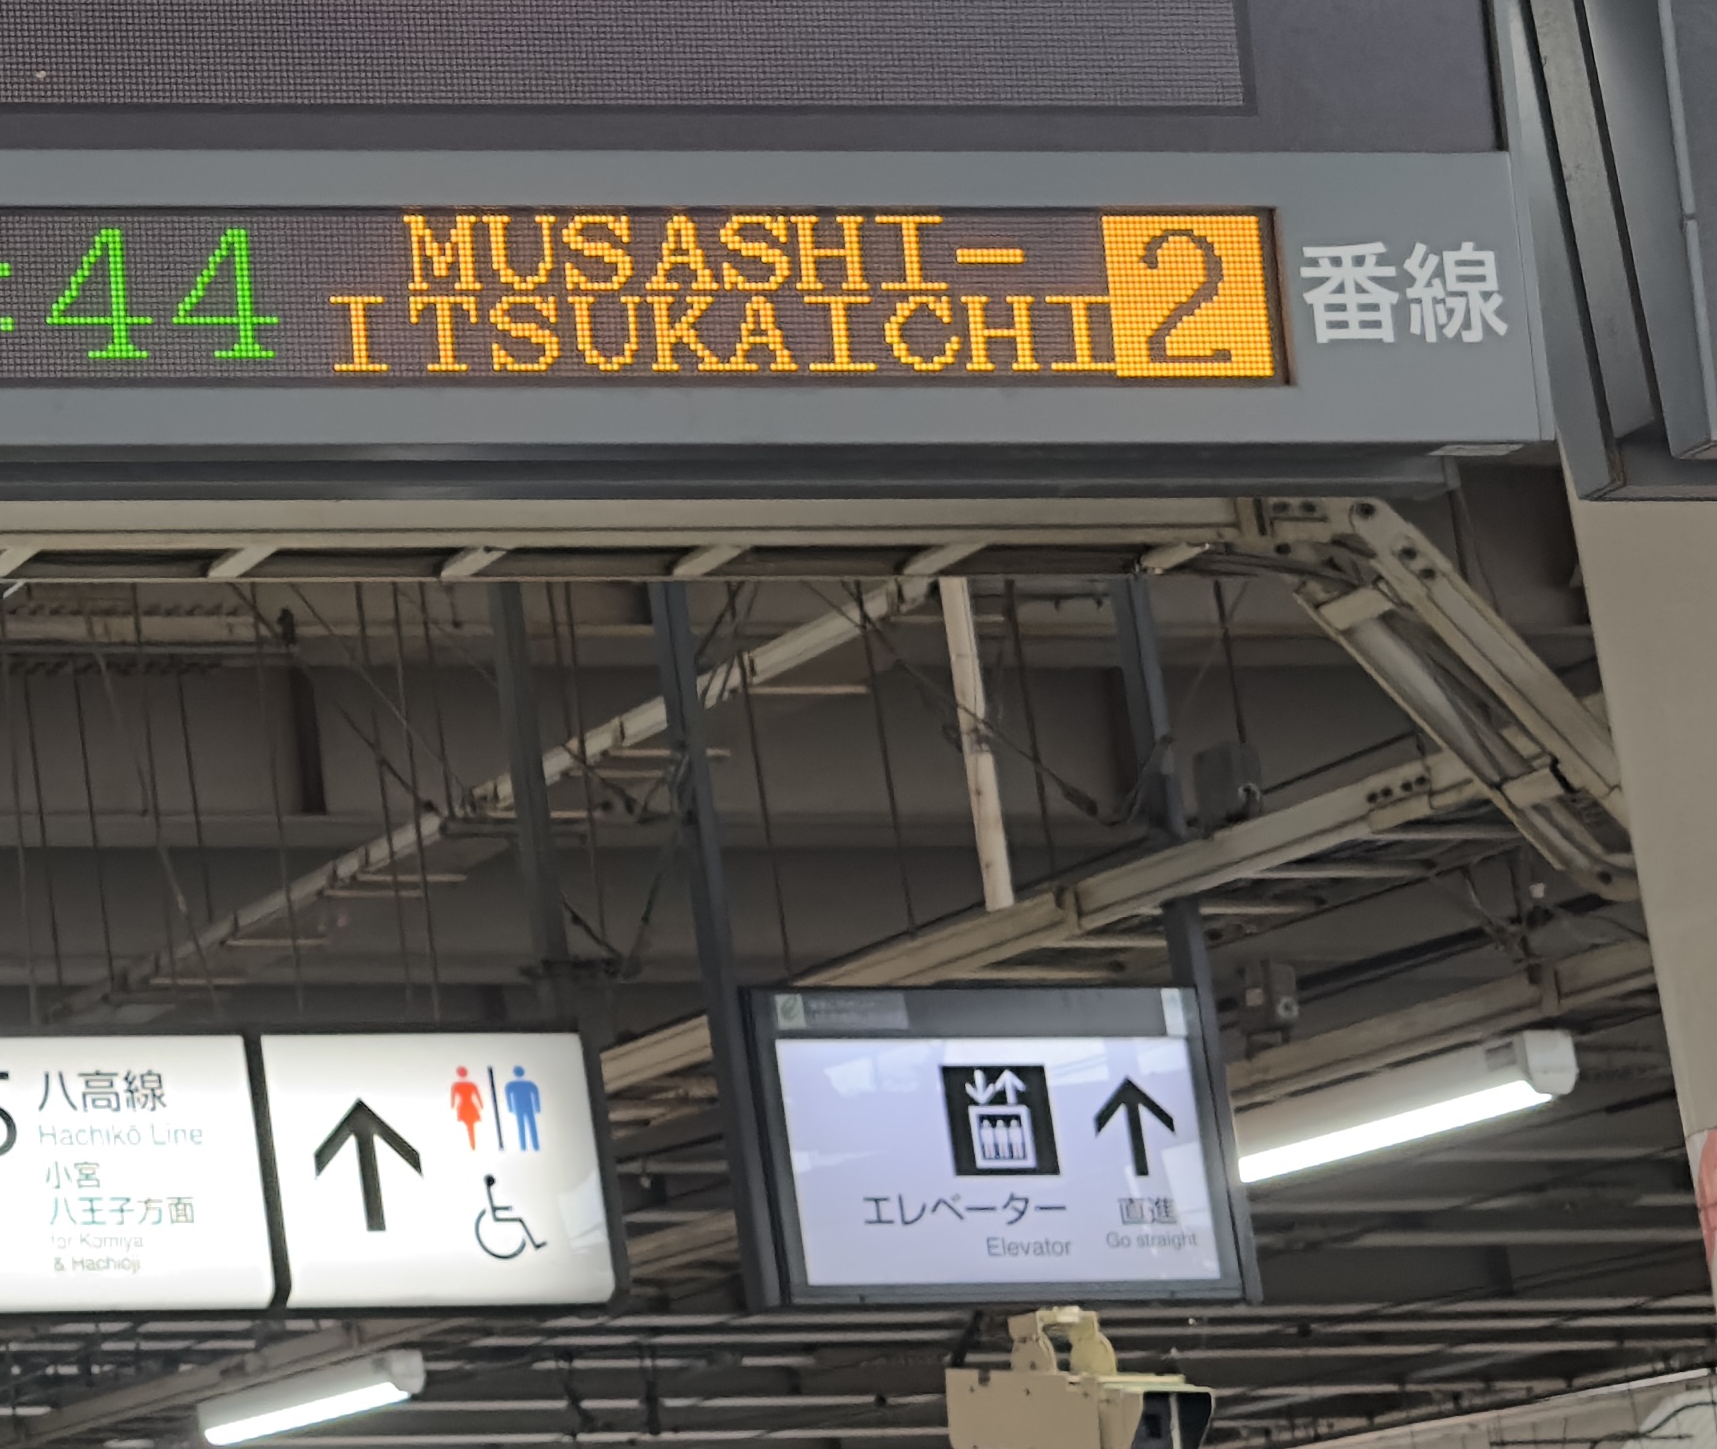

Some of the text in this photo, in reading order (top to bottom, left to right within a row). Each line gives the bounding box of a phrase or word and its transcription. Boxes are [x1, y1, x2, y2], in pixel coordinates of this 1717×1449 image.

[403, 212, 1025, 292] MUSASHI-
[1138, 227, 1232, 363] 2
[1299, 239, 1509, 346] 番線
[328, 292, 1117, 373] ITSUKAICHI
[38, 1069, 167, 1112] 八高線
[150, 1123, 203, 1146] Line
[46, 1161, 101, 1189] 小宮
[50, 1196, 194, 1225] 八王子方面
[863, 1192, 1067, 1225] エレベーター
[1118, 1196, 1178, 1226] 直進
[986, 1236, 1072, 1257] Elevator
[1106, 1230, 1198, 1251] Go straight
